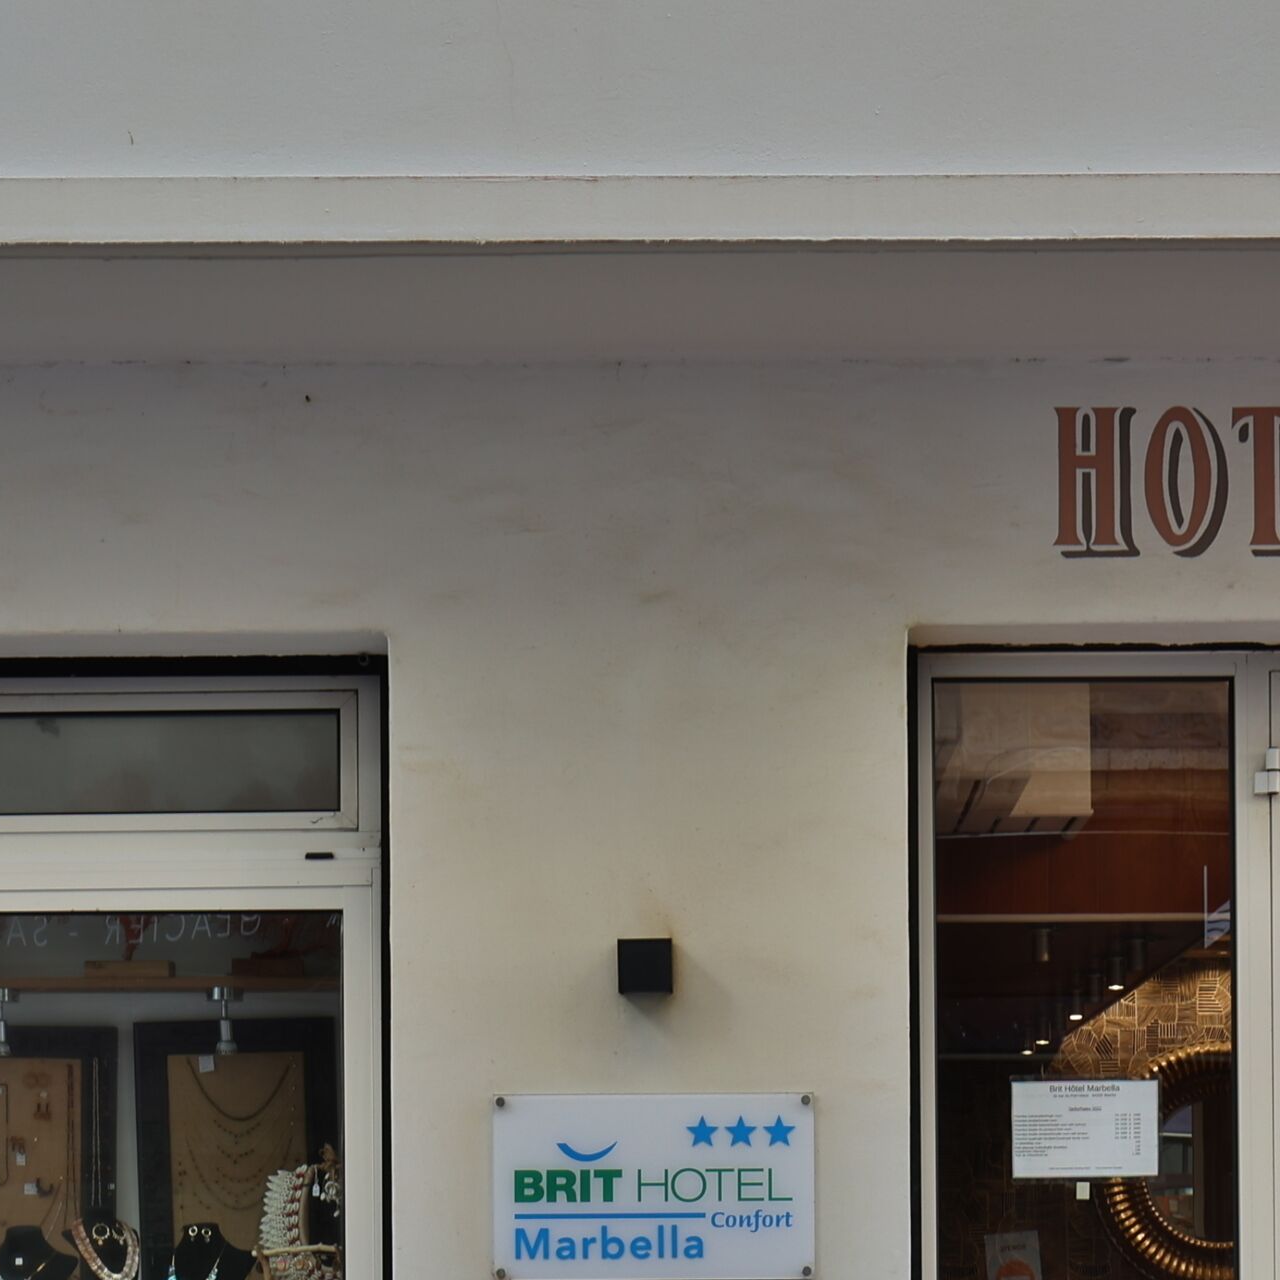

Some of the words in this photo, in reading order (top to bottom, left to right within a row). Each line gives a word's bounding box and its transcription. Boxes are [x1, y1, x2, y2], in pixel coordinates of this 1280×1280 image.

[1049, 1084, 1063, 1093] Brit
[1064, 1083, 1085, 1093] Hôtel
[1087, 1084, 1121, 1093] Marbella
[514, 1168, 623, 1204] BRIT
[637, 1167, 793, 1203] HOTEL
[710, 1208, 793, 1233] Confort
[514, 1224, 705, 1261] Marbella
